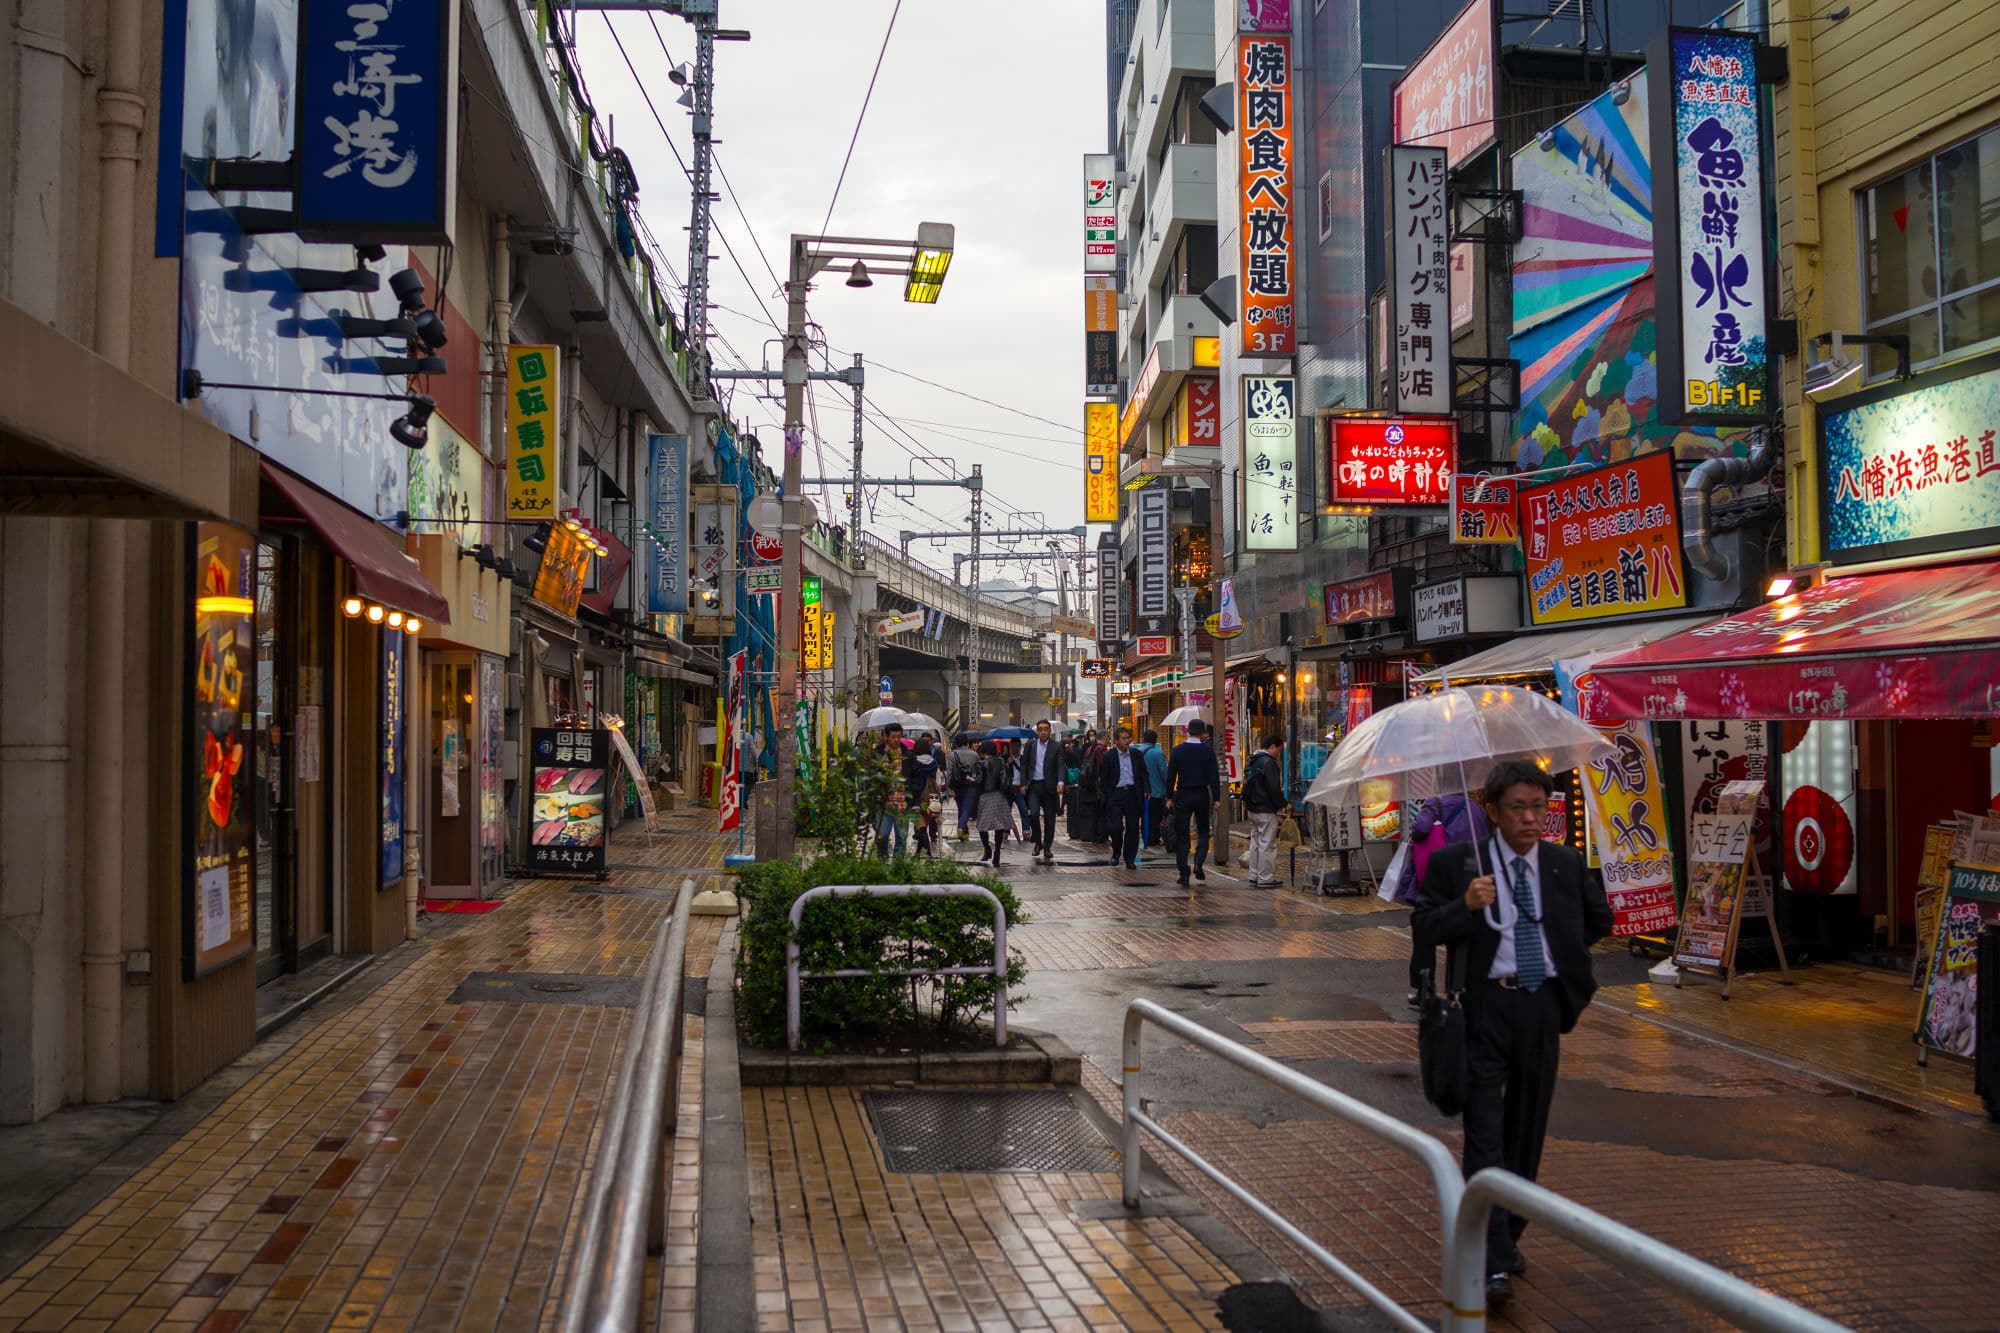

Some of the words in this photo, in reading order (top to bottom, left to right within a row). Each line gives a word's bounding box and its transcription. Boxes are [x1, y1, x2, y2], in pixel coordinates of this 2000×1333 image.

[1689, 54, 1743, 78] 八幡浜
[1681, 80, 1752, 107] 漁港直送
[1245, 41, 1289, 298] 焼肉食べ放題
[1088, 217, 1114, 226] たばこ
[1687, 116, 1752, 366] 魚鮮水産
[1407, 160, 1432, 397] ハンバーグ専門店
[1246, 304, 1292, 328] 肉の街
[1251, 332, 1287, 352] 3F
[515, 352, 548, 482] 回転寿司
[1192, 378, 1215, 439] マンガ
[1091, 412, 1101, 453] マンガ
[1351, 445, 1446, 459] サッポロこだわりラーメン
[1106, 411, 1116, 515] インターネット
[1339, 458, 1450, 493] 味の時計台
[1836, 429, 2000, 503] 八幡浜漁港直
[511, 498, 551, 511] 大江戸
[1280, 460, 1293, 526] 回転すし
[1548, 470, 1639, 521] 呑み処大衆店
[657, 448, 680, 593] 美生堂薬局
[1460, 509, 1514, 538] 新八
[1533, 501, 1546, 559] 上野
[1143, 492, 1165, 613] COFFEE
[1567, 568, 1621, 609] 旨居屋
[1617, 544, 1681, 604] 新八
[1101, 550, 1118, 640] COFFEE
[1417, 600, 1463, 624] ハンバーグ専門店
[1643, 688, 1687, 718] はなの舞
[1789, 682, 1848, 717] はなの舞
[556, 732, 592, 747] 回転
[556, 748, 592, 762] 寿司
[1694, 820, 1750, 858] 忘年会
